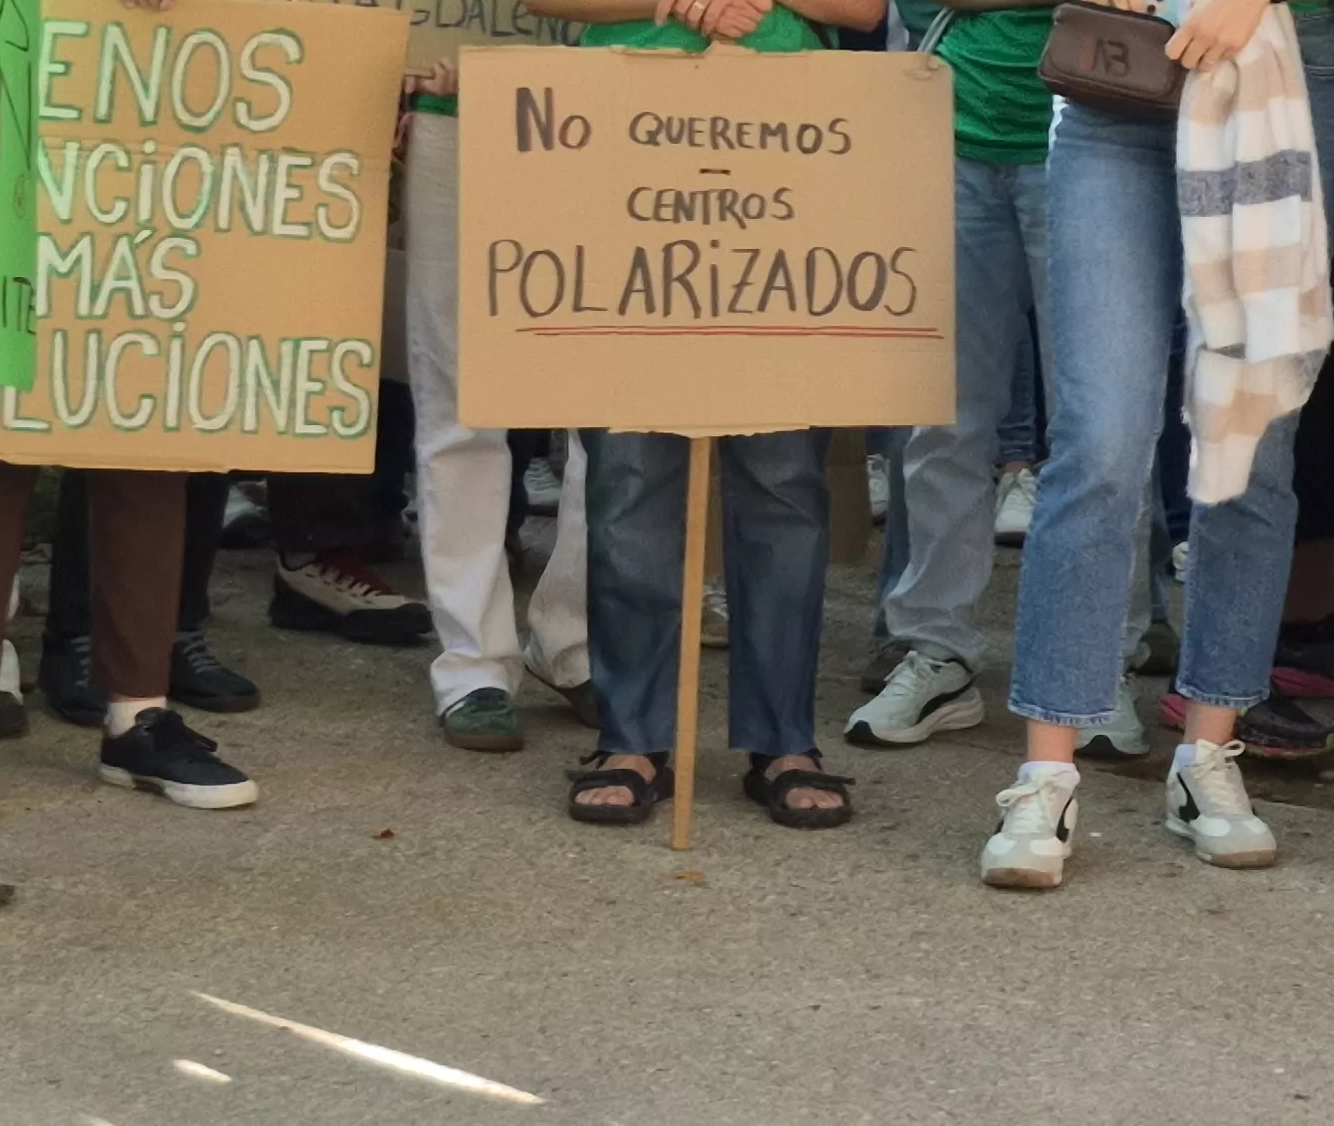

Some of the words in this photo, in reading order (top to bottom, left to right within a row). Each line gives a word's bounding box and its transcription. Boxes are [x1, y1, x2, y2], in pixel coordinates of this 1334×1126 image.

[39, 18, 304, 132] ENOS
[629, 111, 852, 155] QUEREMOS
[627, 186, 795, 230] CENTROS
[36, 228, 201, 319] MÁS
